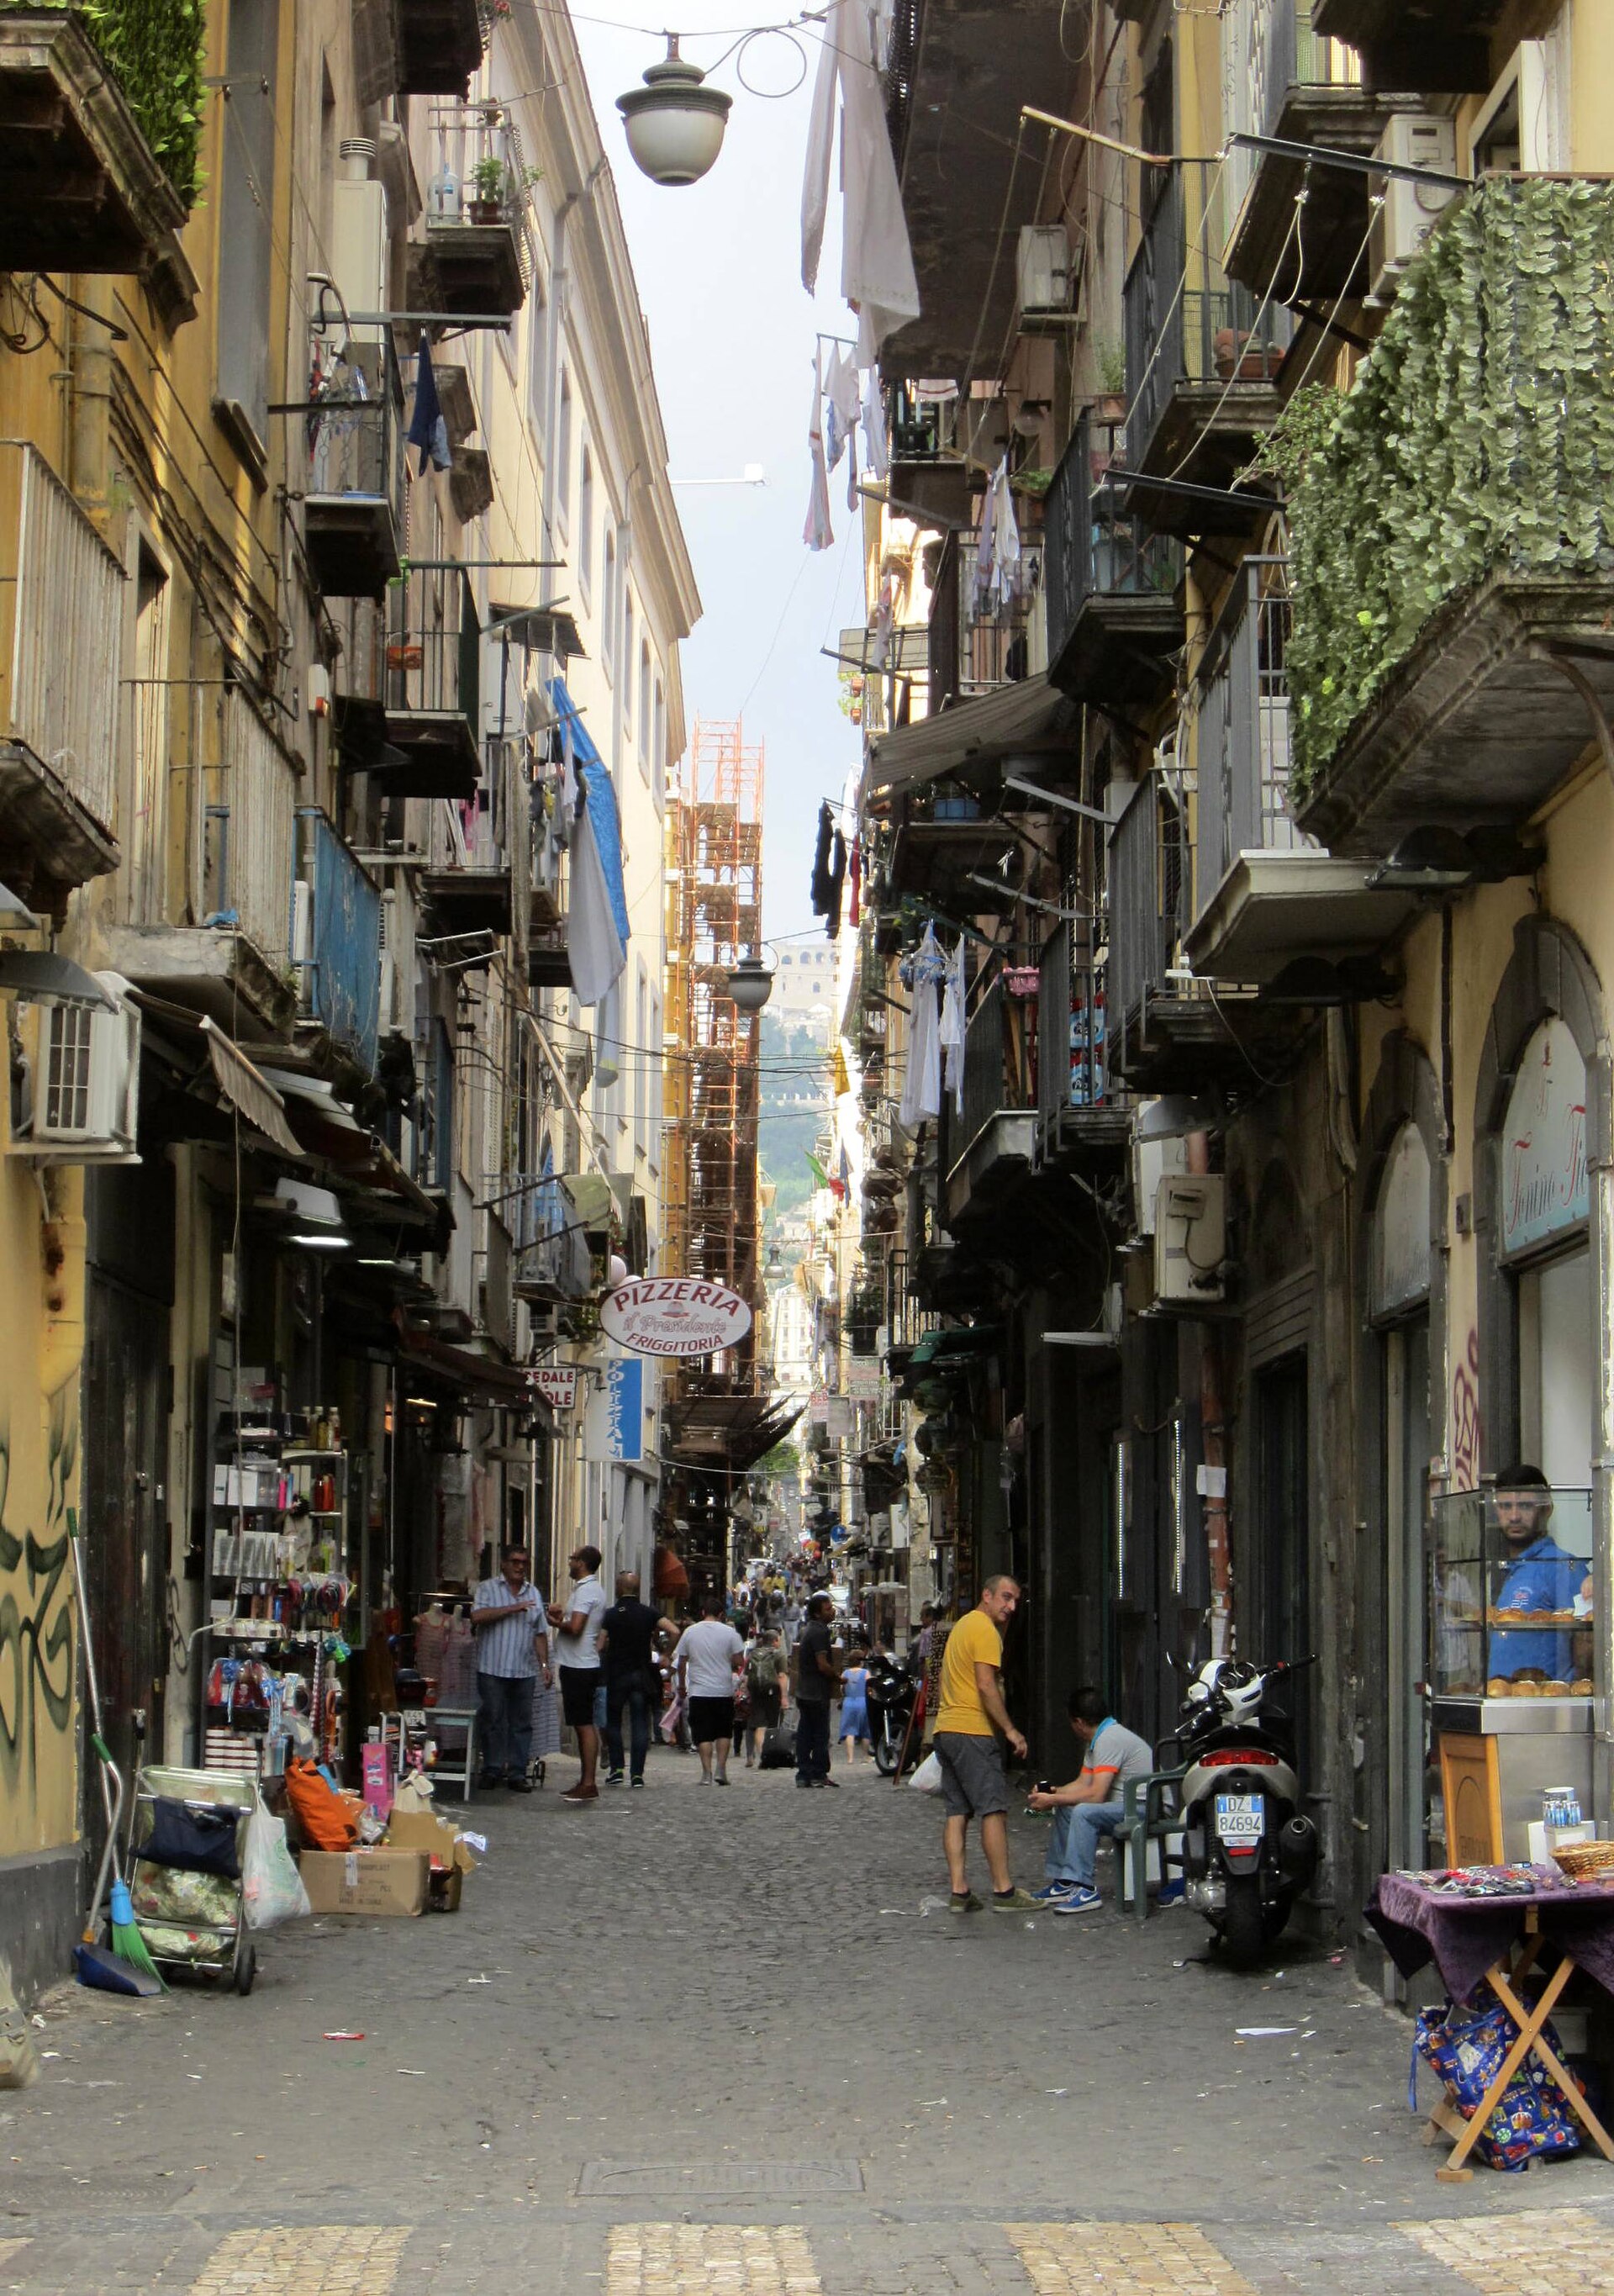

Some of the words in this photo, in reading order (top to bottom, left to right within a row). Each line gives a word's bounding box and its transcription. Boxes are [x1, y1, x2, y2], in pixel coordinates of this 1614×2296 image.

[614, 1282, 741, 1317] PIZZERIA
[640, 1313, 727, 1334] Presidente
[626, 1333, 724, 1352] FRIGGITORIA
[1228, 1797, 1244, 1812] DZ
[1220, 1816, 1261, 1831] 84694
